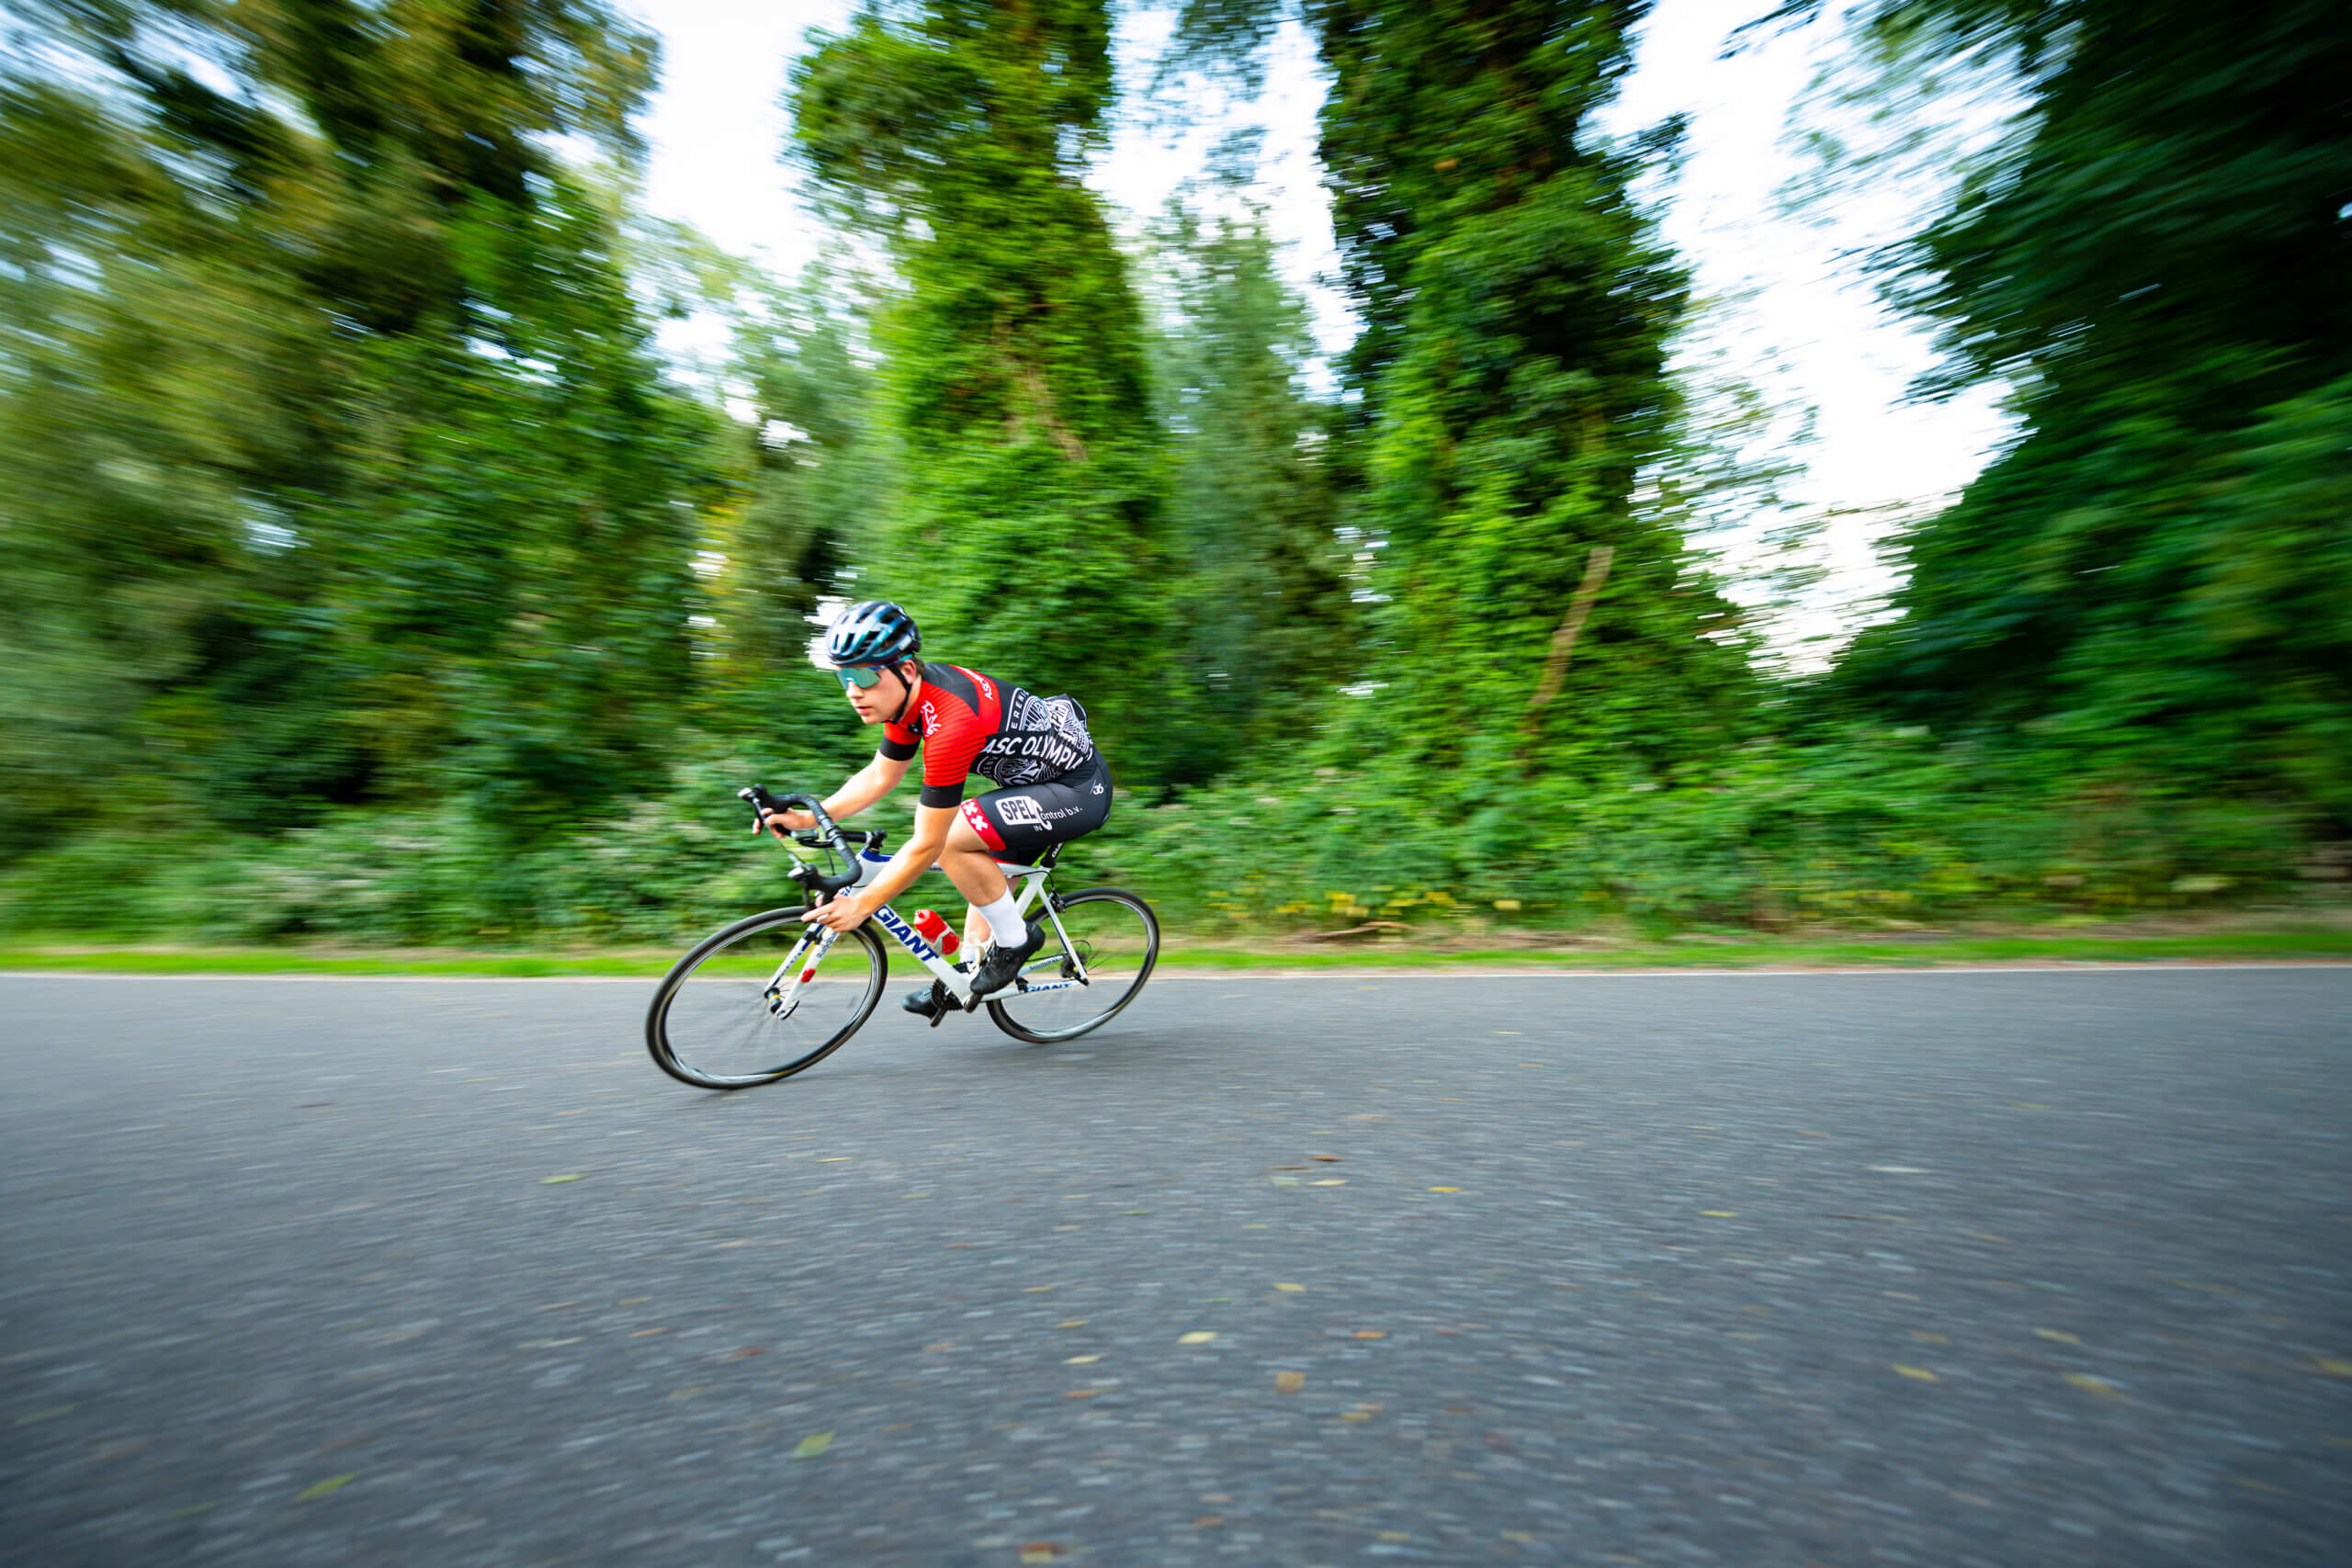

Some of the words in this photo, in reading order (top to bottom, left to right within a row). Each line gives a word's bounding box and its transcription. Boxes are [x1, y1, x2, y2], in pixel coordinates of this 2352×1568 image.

[981, 736, 1022, 756] ASC
[1001, 799, 1037, 820] SPEL
[874, 905, 939, 962] GIANT
